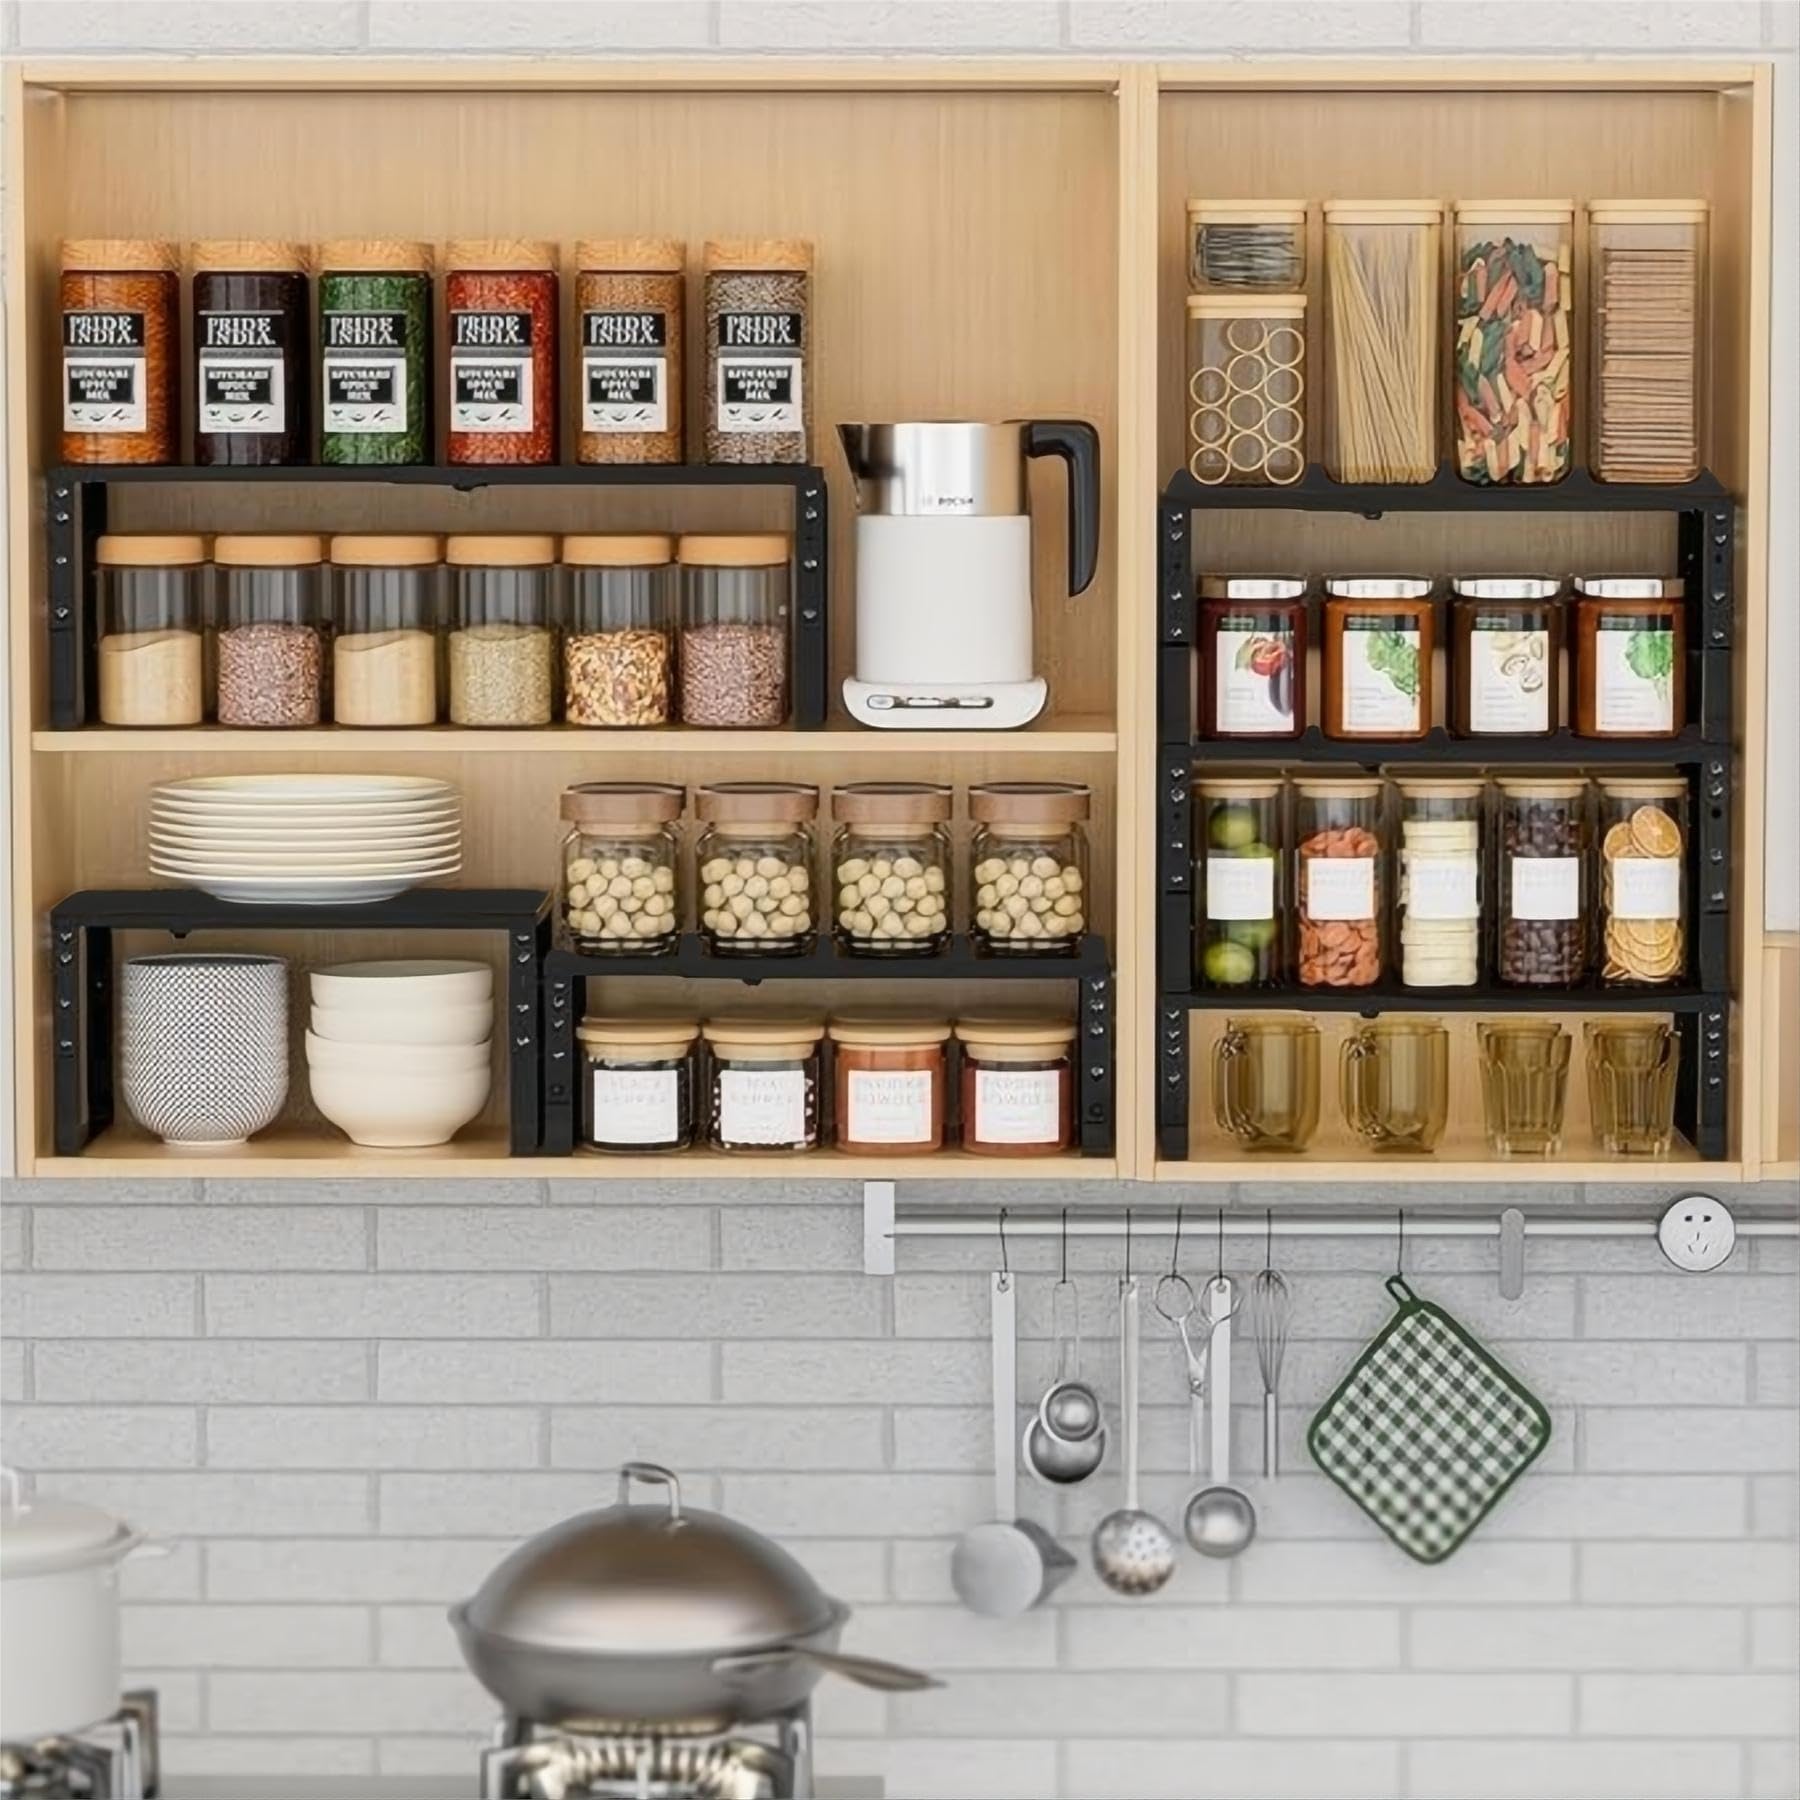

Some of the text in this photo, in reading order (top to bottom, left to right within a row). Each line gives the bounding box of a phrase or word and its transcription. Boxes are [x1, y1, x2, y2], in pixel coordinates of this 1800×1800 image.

[70, 315, 132, 331] PRIDE
[207, 316, 271, 332] PRIDE
[330, 316, 393, 332] PRIDE
[458, 315, 519, 331] PRIDE
[590, 315, 654, 331] PRIDE
[726, 315, 791, 331] PRIDE
